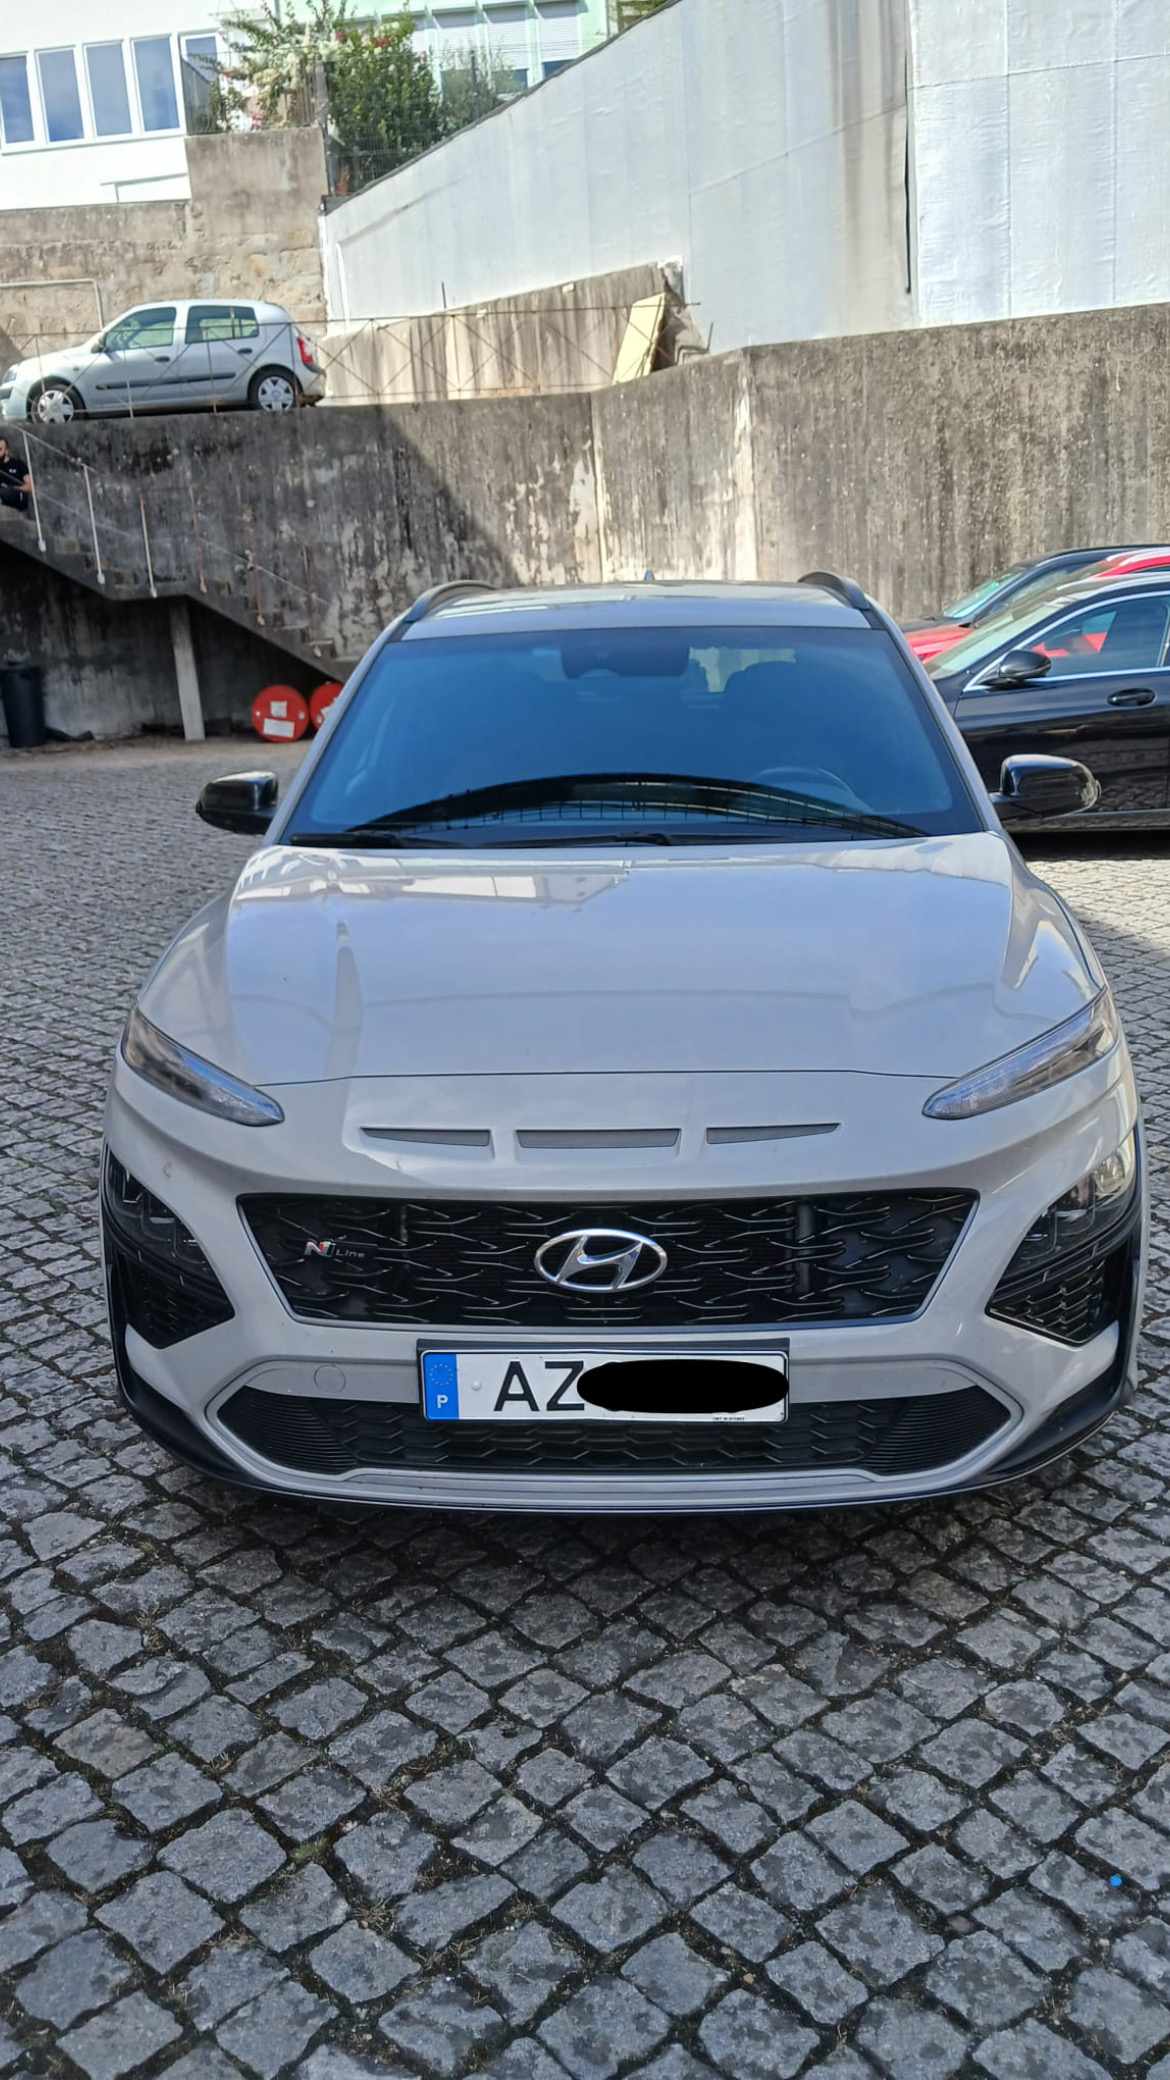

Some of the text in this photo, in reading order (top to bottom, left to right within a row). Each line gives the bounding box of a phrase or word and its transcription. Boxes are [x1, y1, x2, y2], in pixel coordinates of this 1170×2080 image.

[304, 1240, 365, 1258] N Line
[493, 1360, 585, 1412] AZ
[436, 1394, 449, 1409] P
